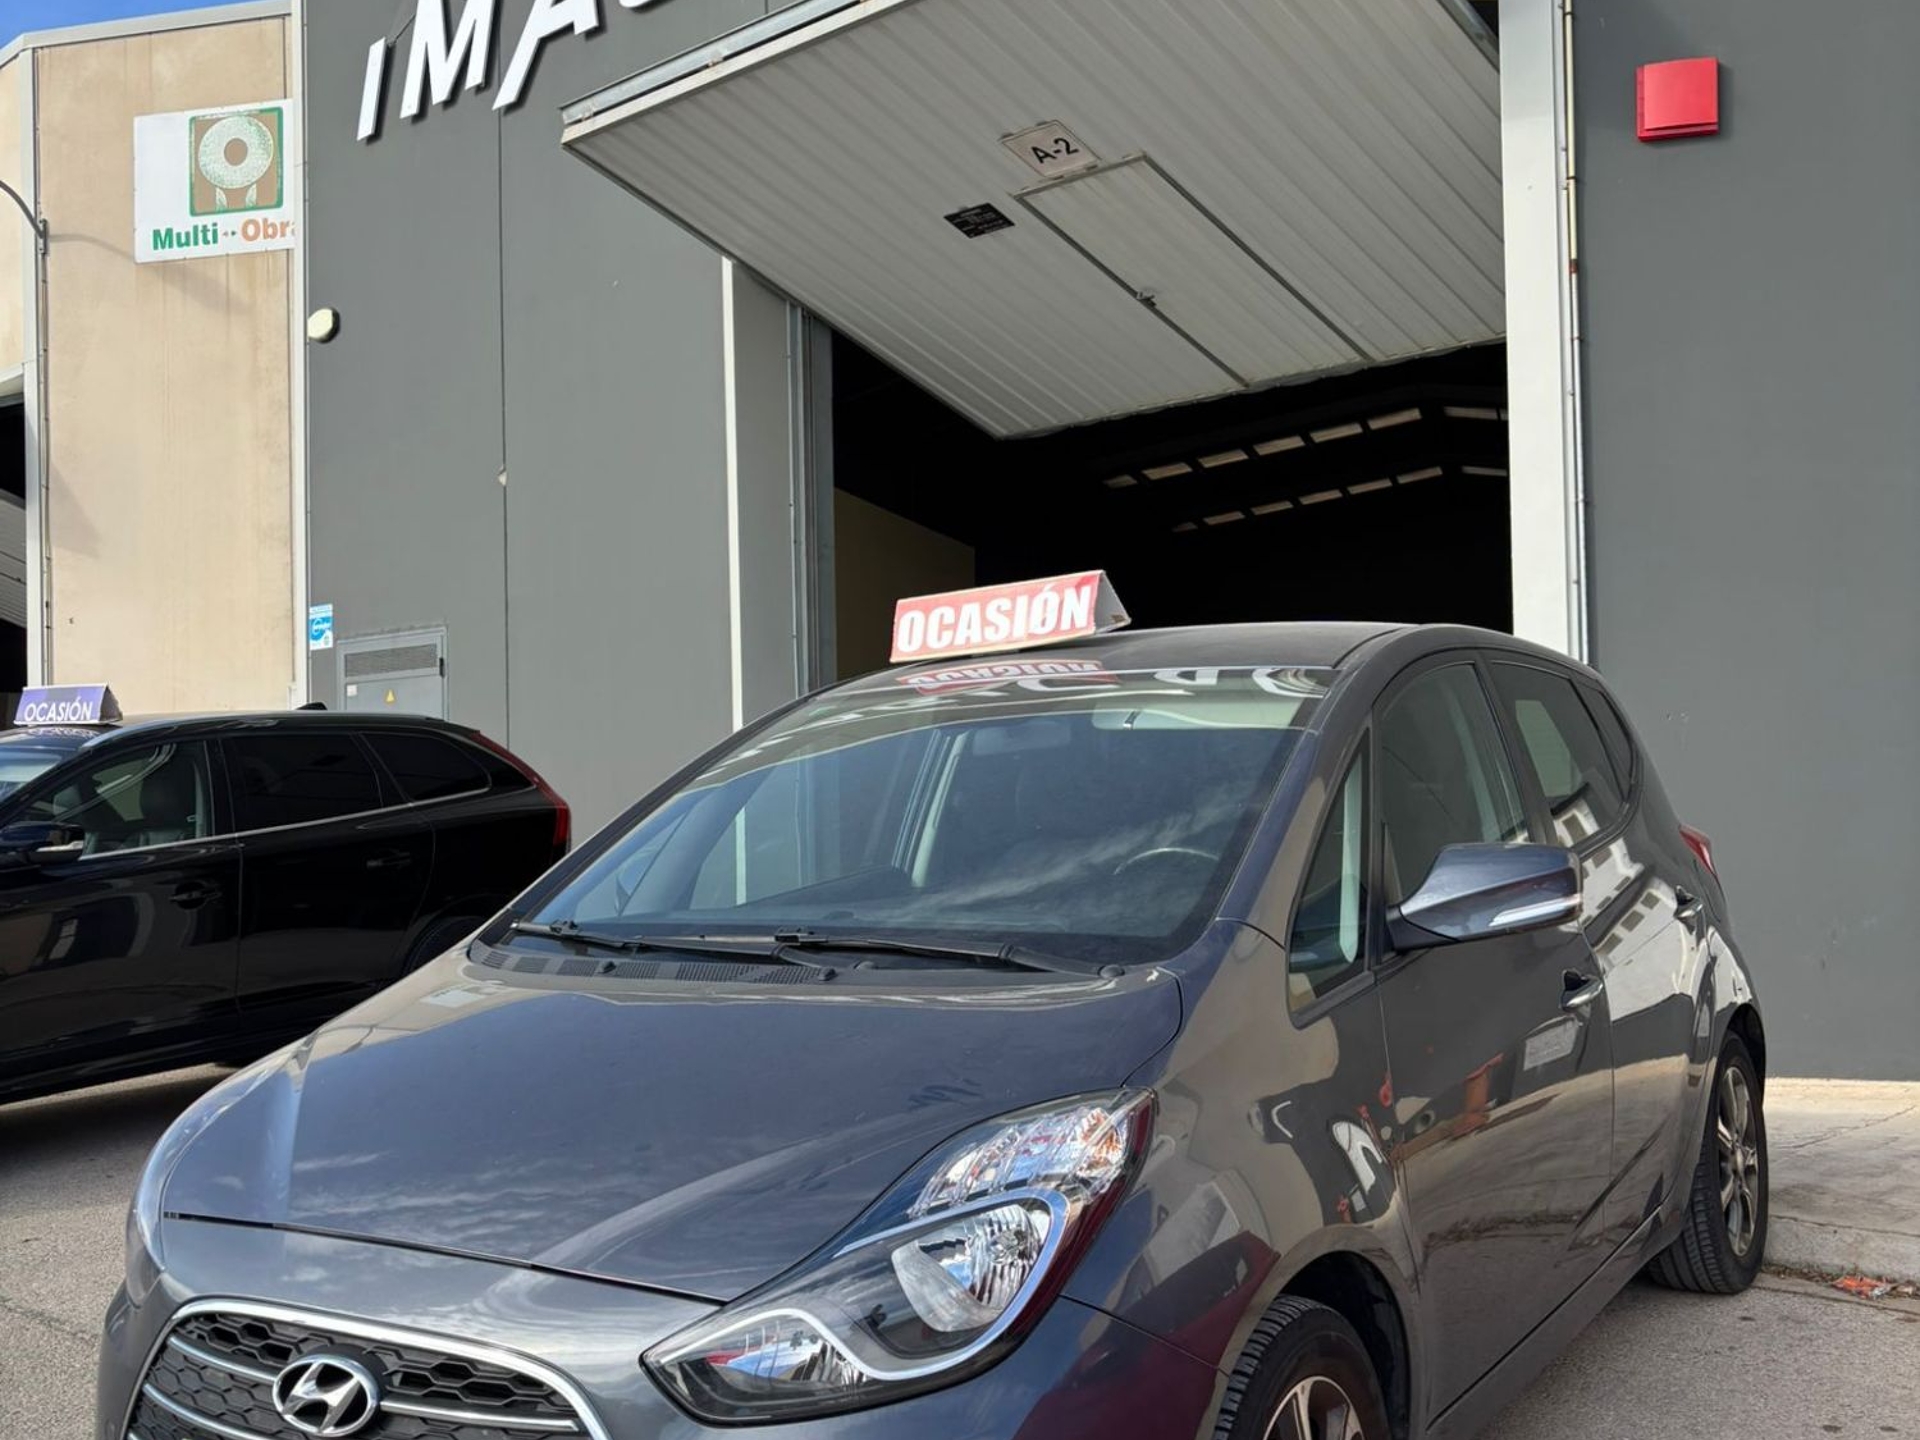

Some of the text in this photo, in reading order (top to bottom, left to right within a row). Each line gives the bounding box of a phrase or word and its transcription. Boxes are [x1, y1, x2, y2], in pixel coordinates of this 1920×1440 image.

[357, 0, 664, 141] IMA
[1030, 137, 1079, 164] A-2
[152, 222, 218, 251] Multi
[896, 585, 1092, 653] OCASIÓN
[24, 696, 94, 721] OCASIÓN
